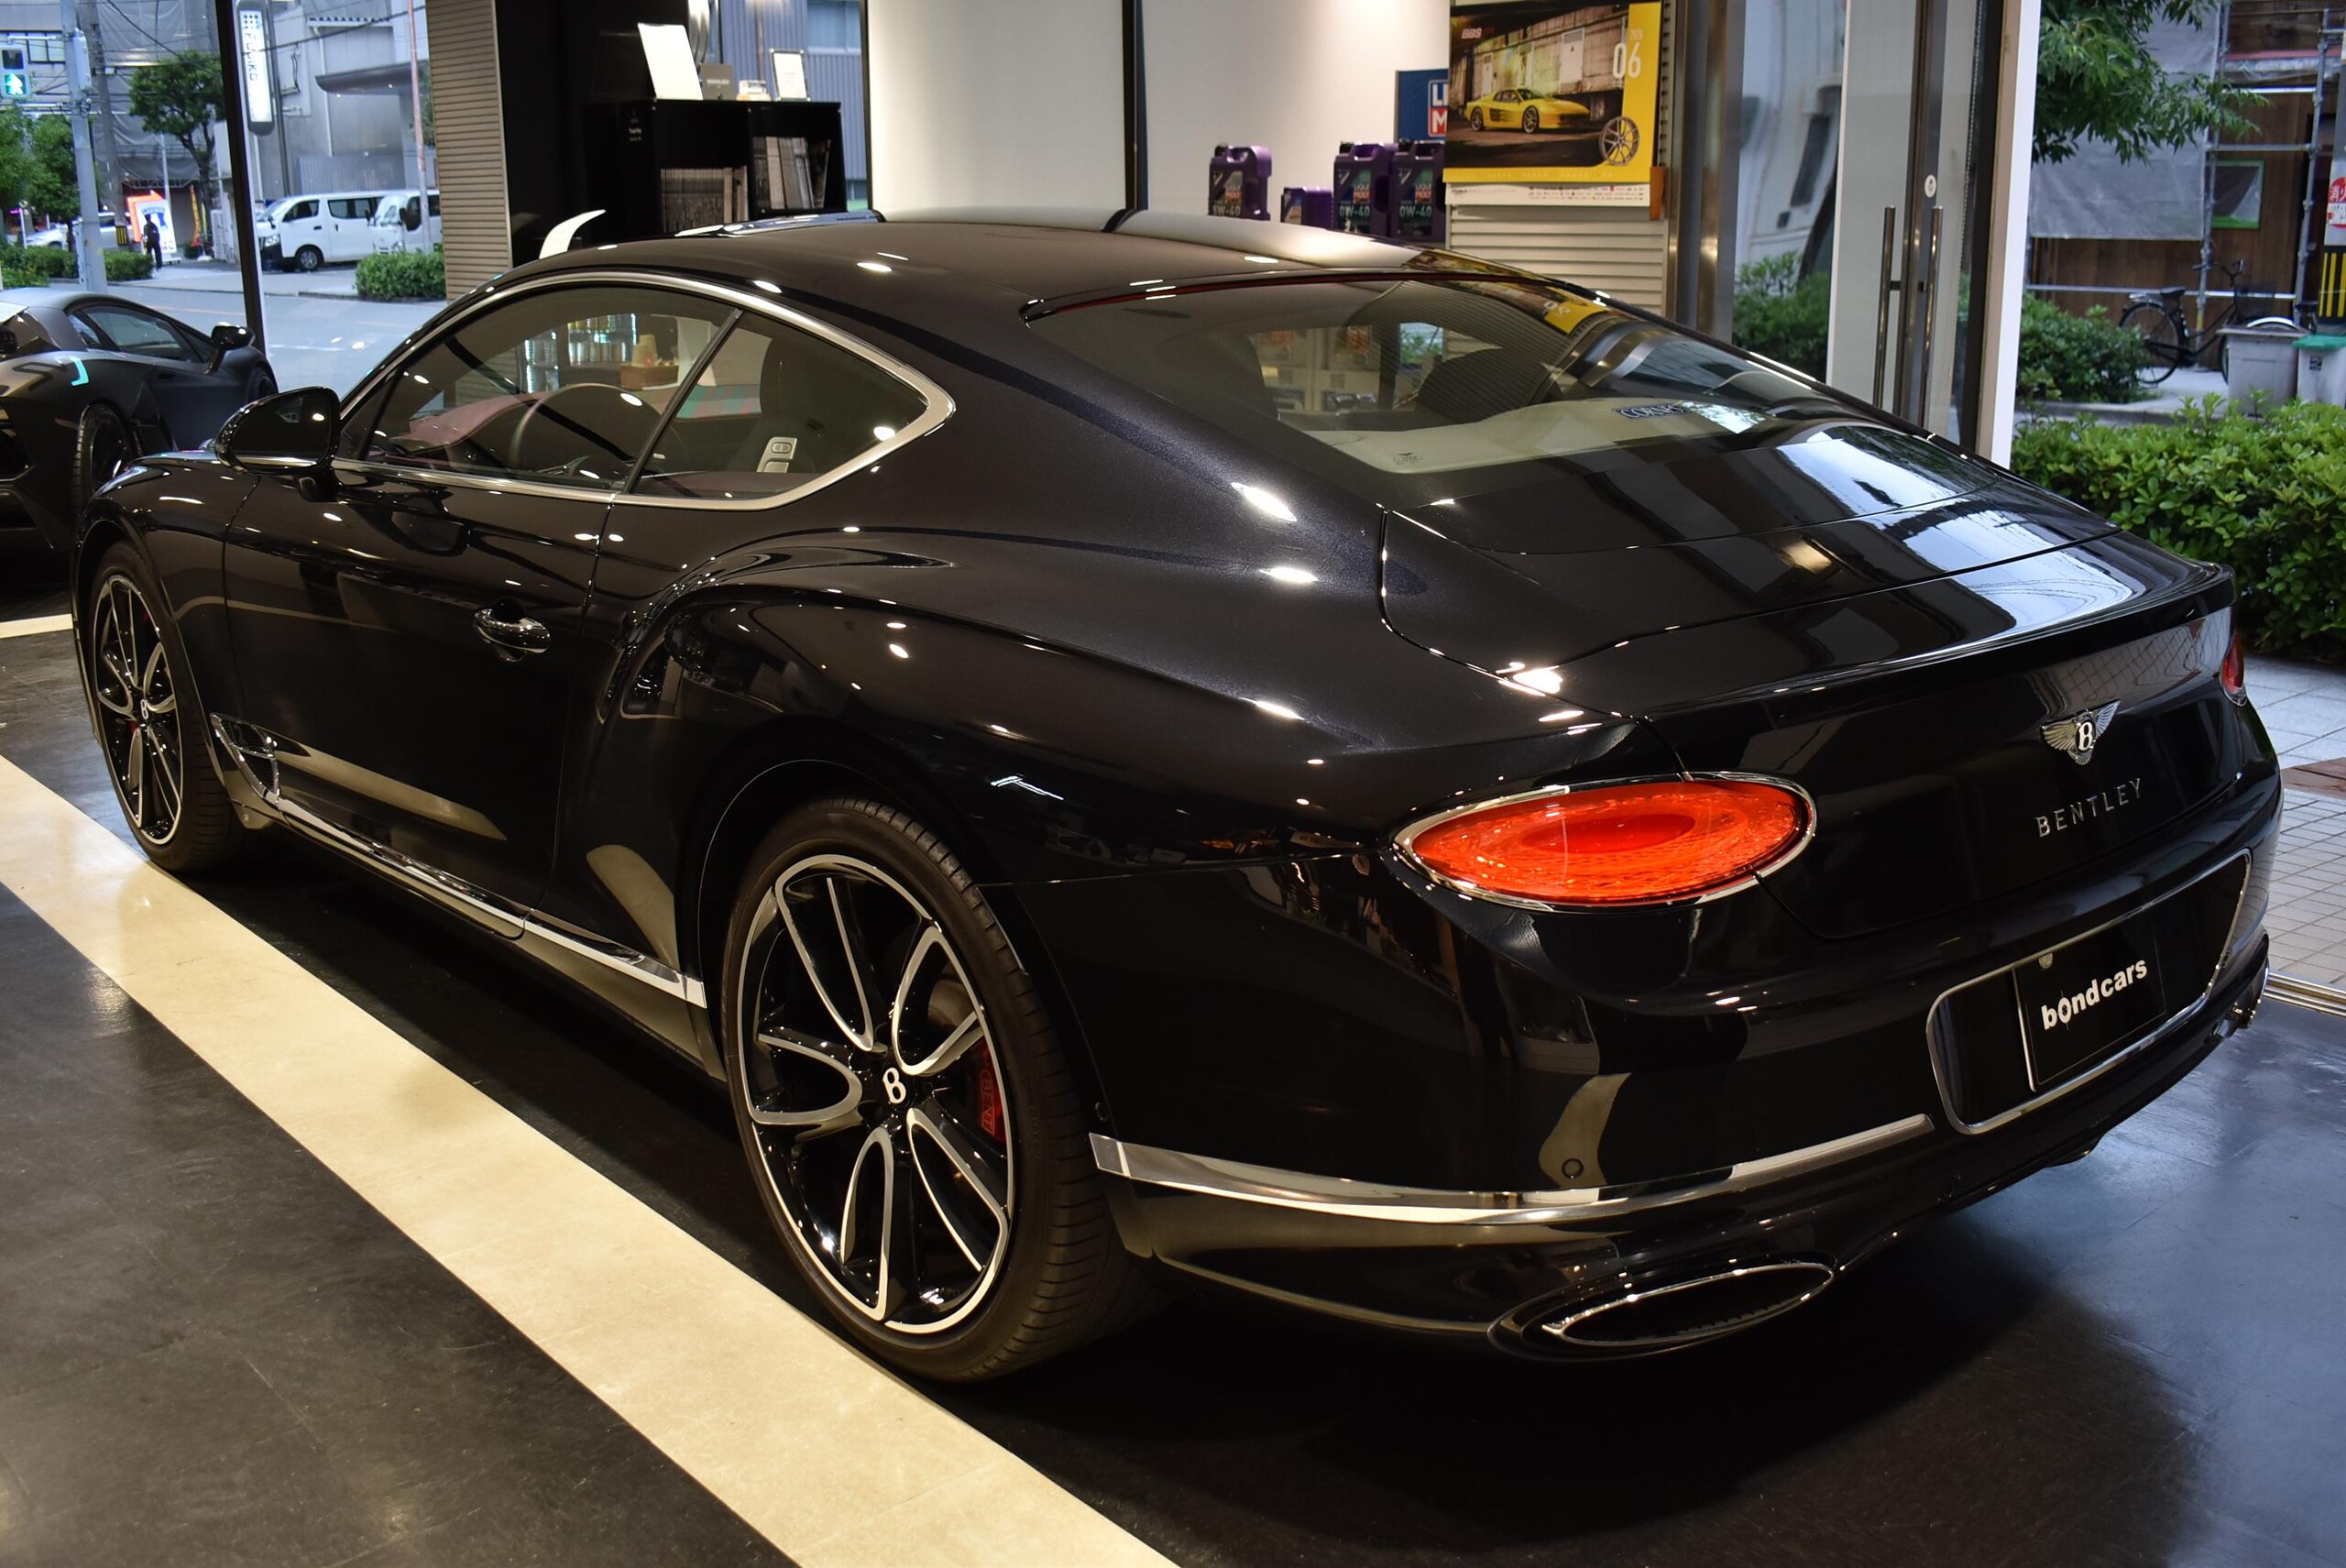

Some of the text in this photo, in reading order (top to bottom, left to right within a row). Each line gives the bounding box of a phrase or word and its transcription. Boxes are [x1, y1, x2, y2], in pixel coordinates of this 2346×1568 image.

[1462, 27, 1482, 39] BBS
[1613, 42, 1641, 78] 06
[1339, 205, 1371, 217] 0W-40
[1399, 205, 1432, 218] 0W-40
[2034, 778, 2142, 838] BENTLEY
[882, 1067, 906, 1104] B
[982, 1080, 993, 1130] BENT
